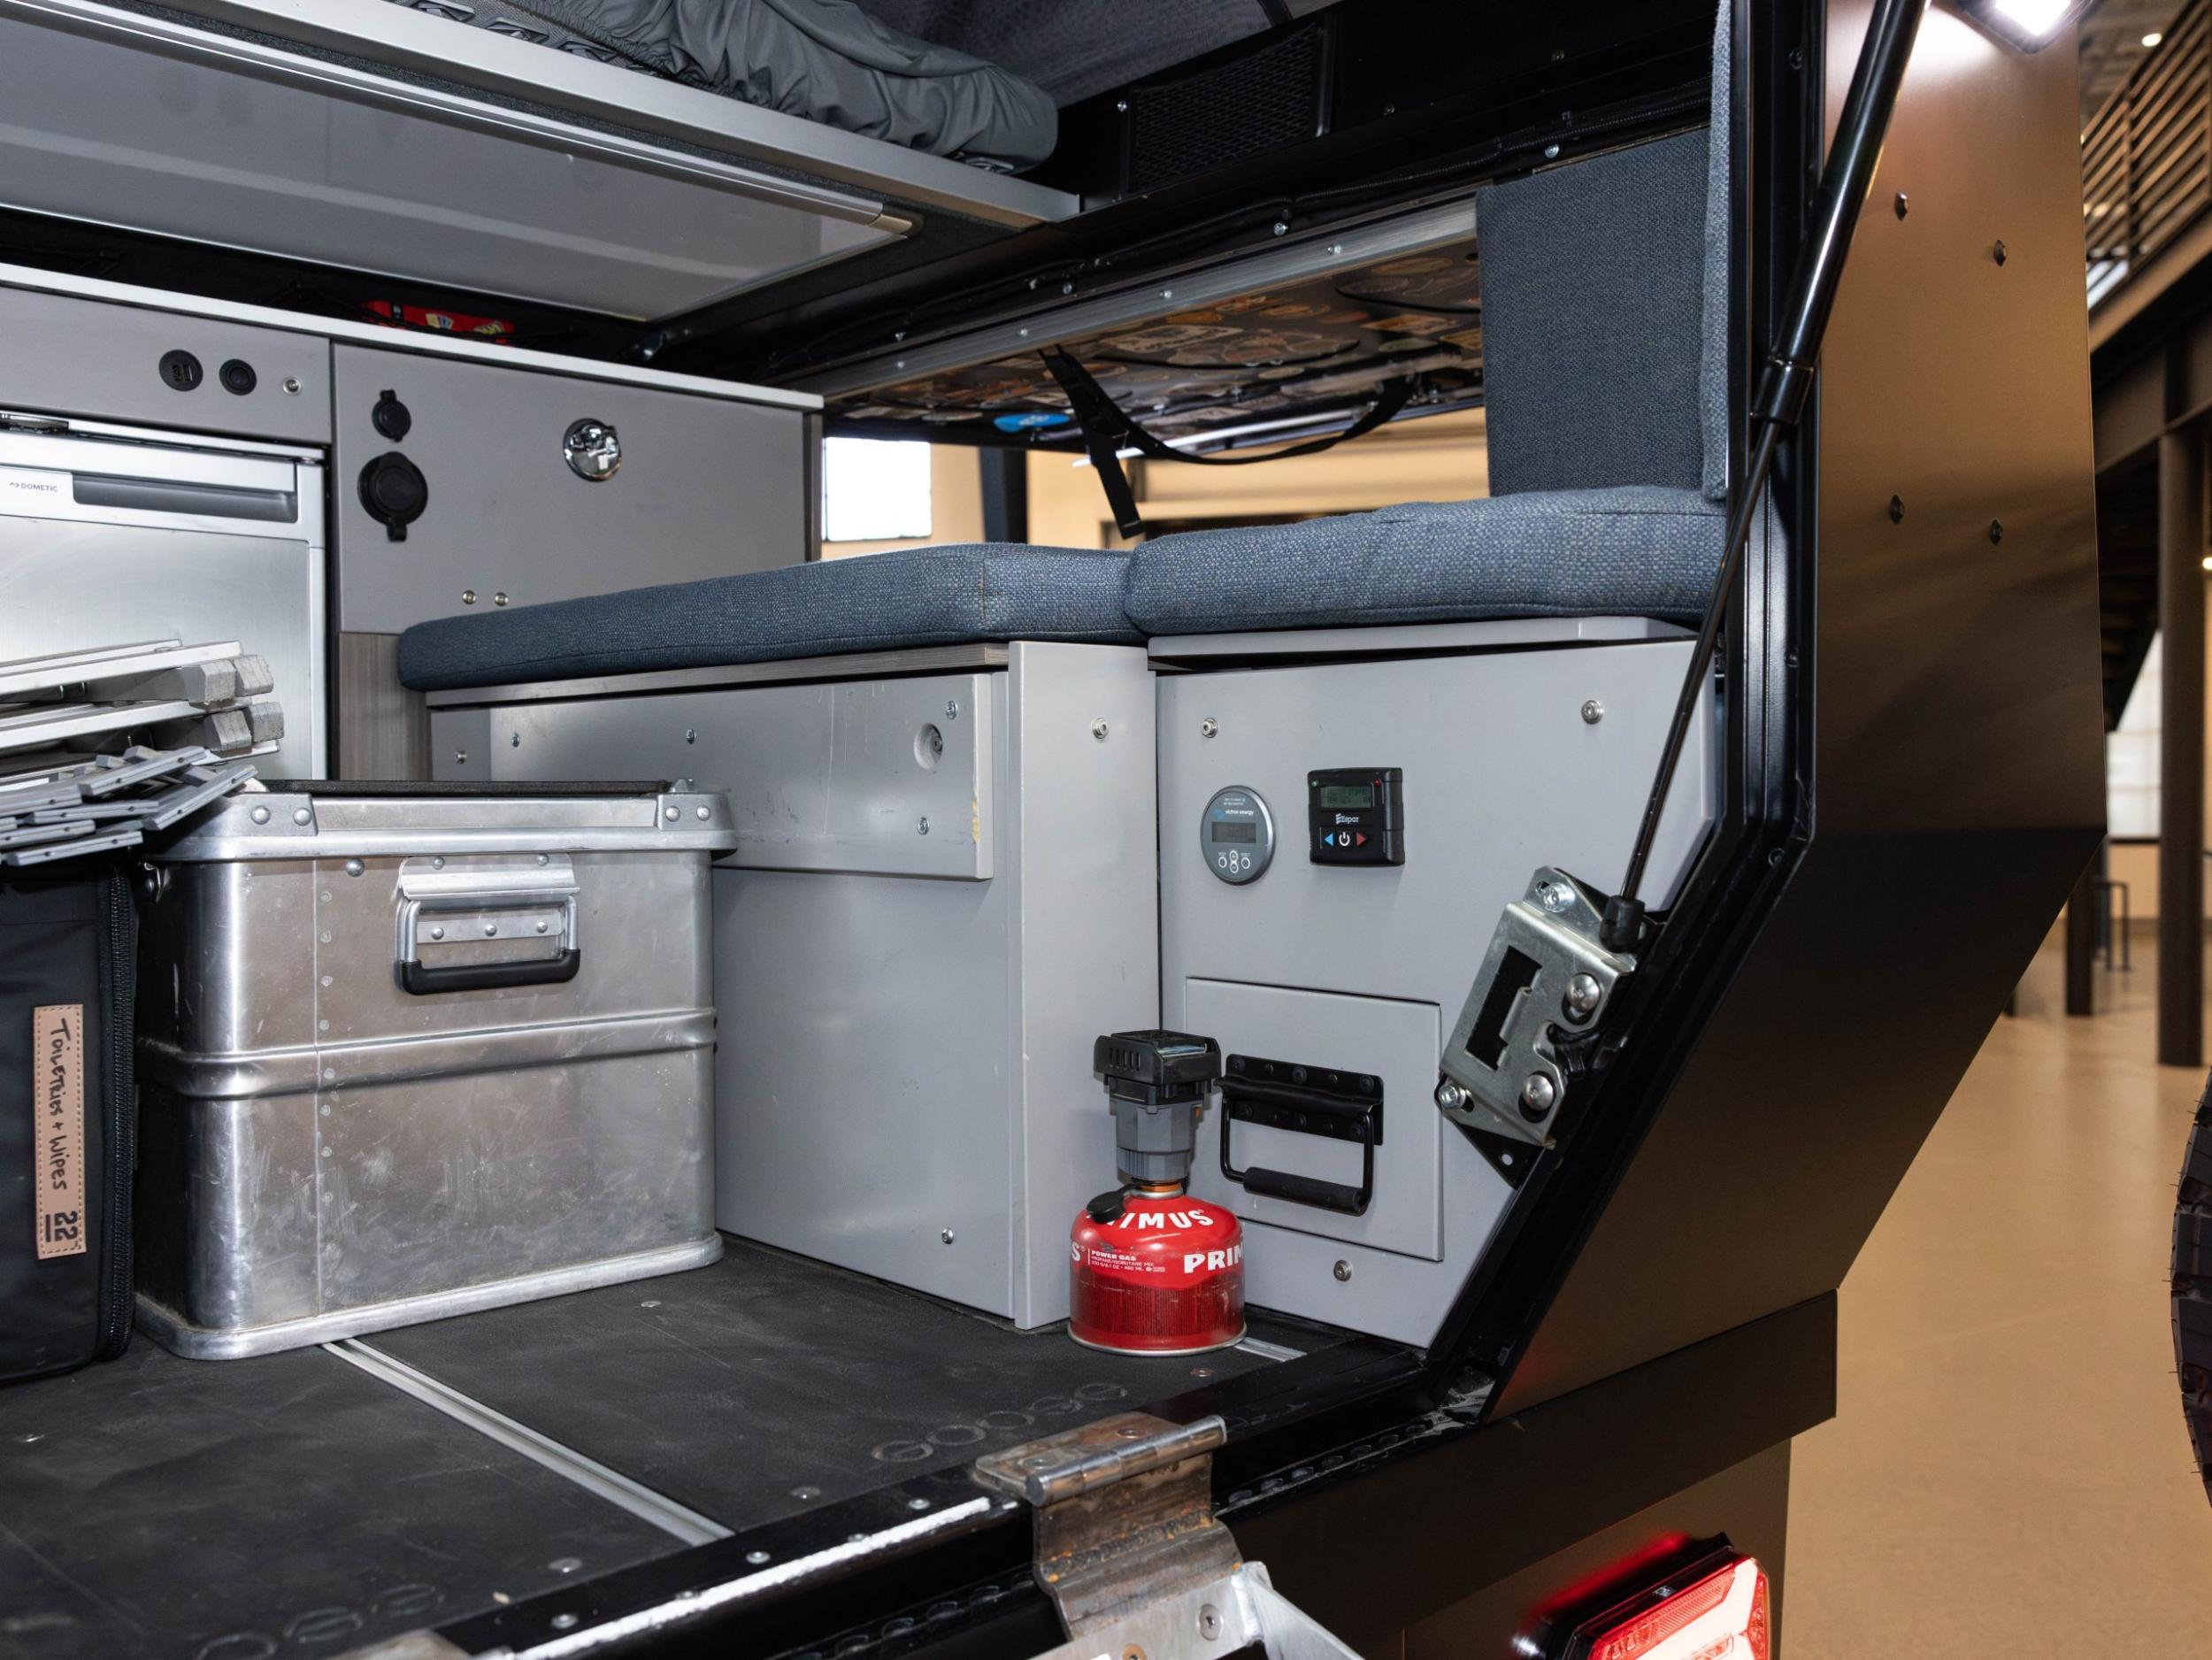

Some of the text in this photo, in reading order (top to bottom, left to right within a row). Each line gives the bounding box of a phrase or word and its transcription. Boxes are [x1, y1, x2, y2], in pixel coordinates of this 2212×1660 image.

[20, 482, 58, 492] DOMETIC
[54, 1210, 79, 1242] 22
[1087, 1210, 1214, 1230] IMUS
[1091, 1249, 1118, 1259] POWER
